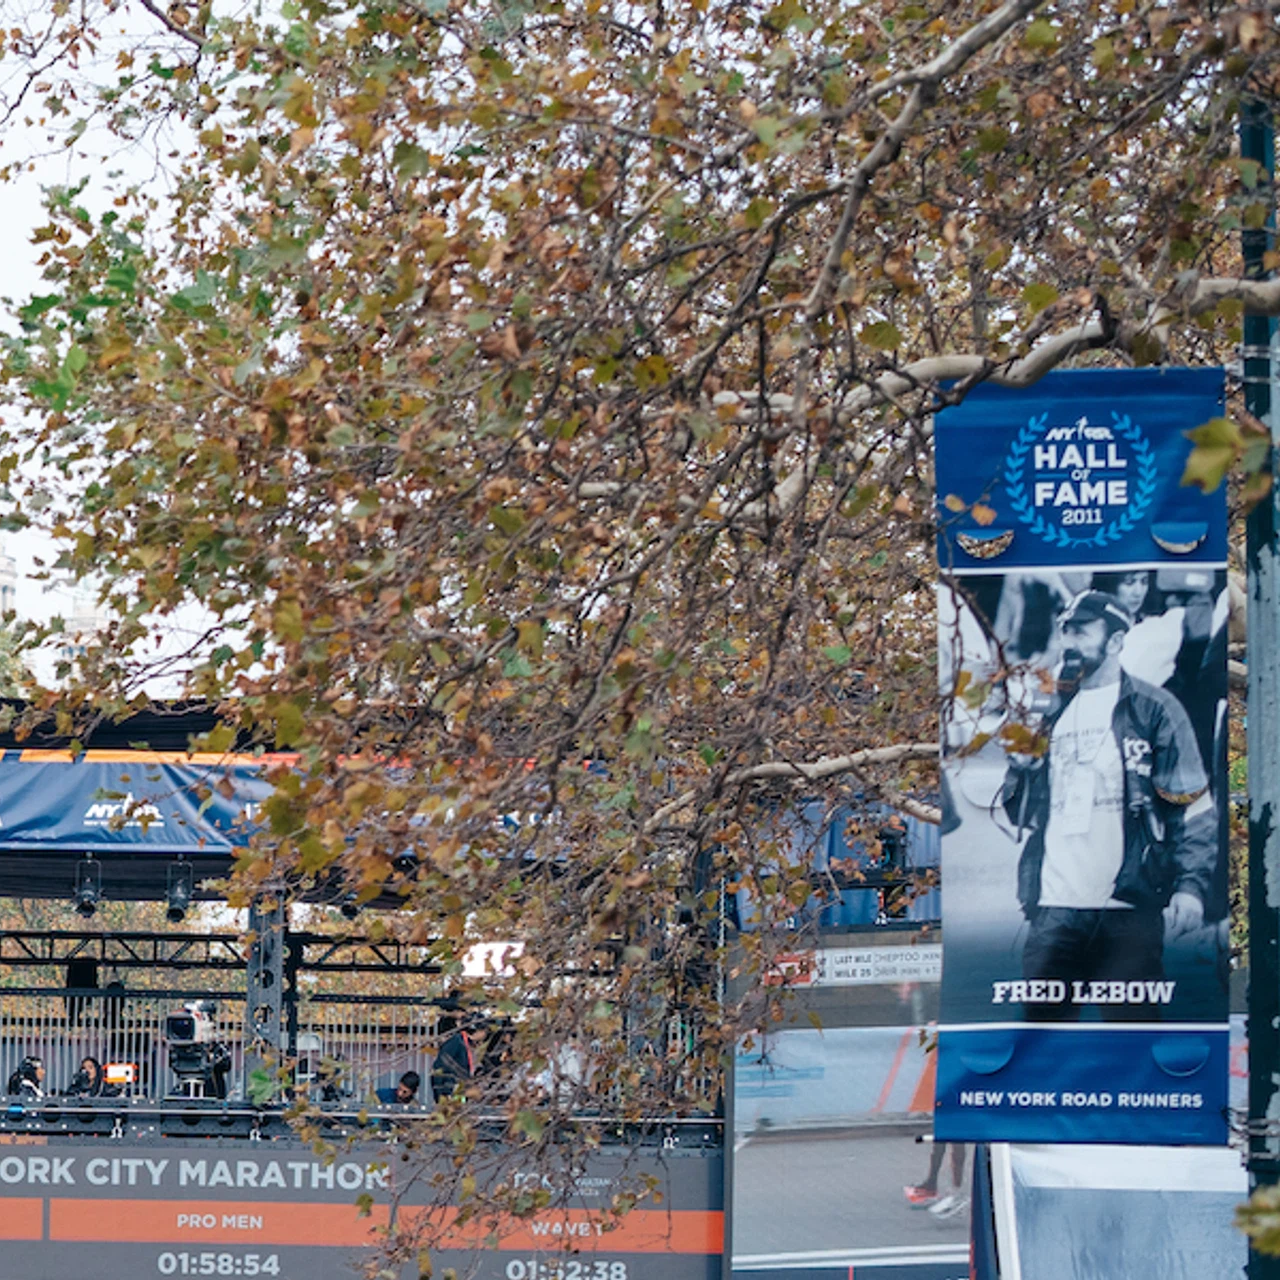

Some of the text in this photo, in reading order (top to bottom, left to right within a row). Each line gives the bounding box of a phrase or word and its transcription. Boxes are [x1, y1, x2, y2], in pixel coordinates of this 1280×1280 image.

[1035, 444, 1127, 469] HALL
[1071, 469, 1091, 480] OF
[1035, 481, 1127, 506] FAME
[1062, 508, 1102, 525] 2011
[991, 980, 1176, 1004] FRED LEBOW
[960, 1092, 1203, 1108] NEW YORK ROAD RUNNERS
[85, 1158, 169, 1186] CITY
[179, 1160, 390, 1190] MARATHON
[177, 1214, 263, 1229] PRO MEN
[532, 1222, 590, 1237] WAVE
[158, 1252, 281, 1276] 01:58:54
